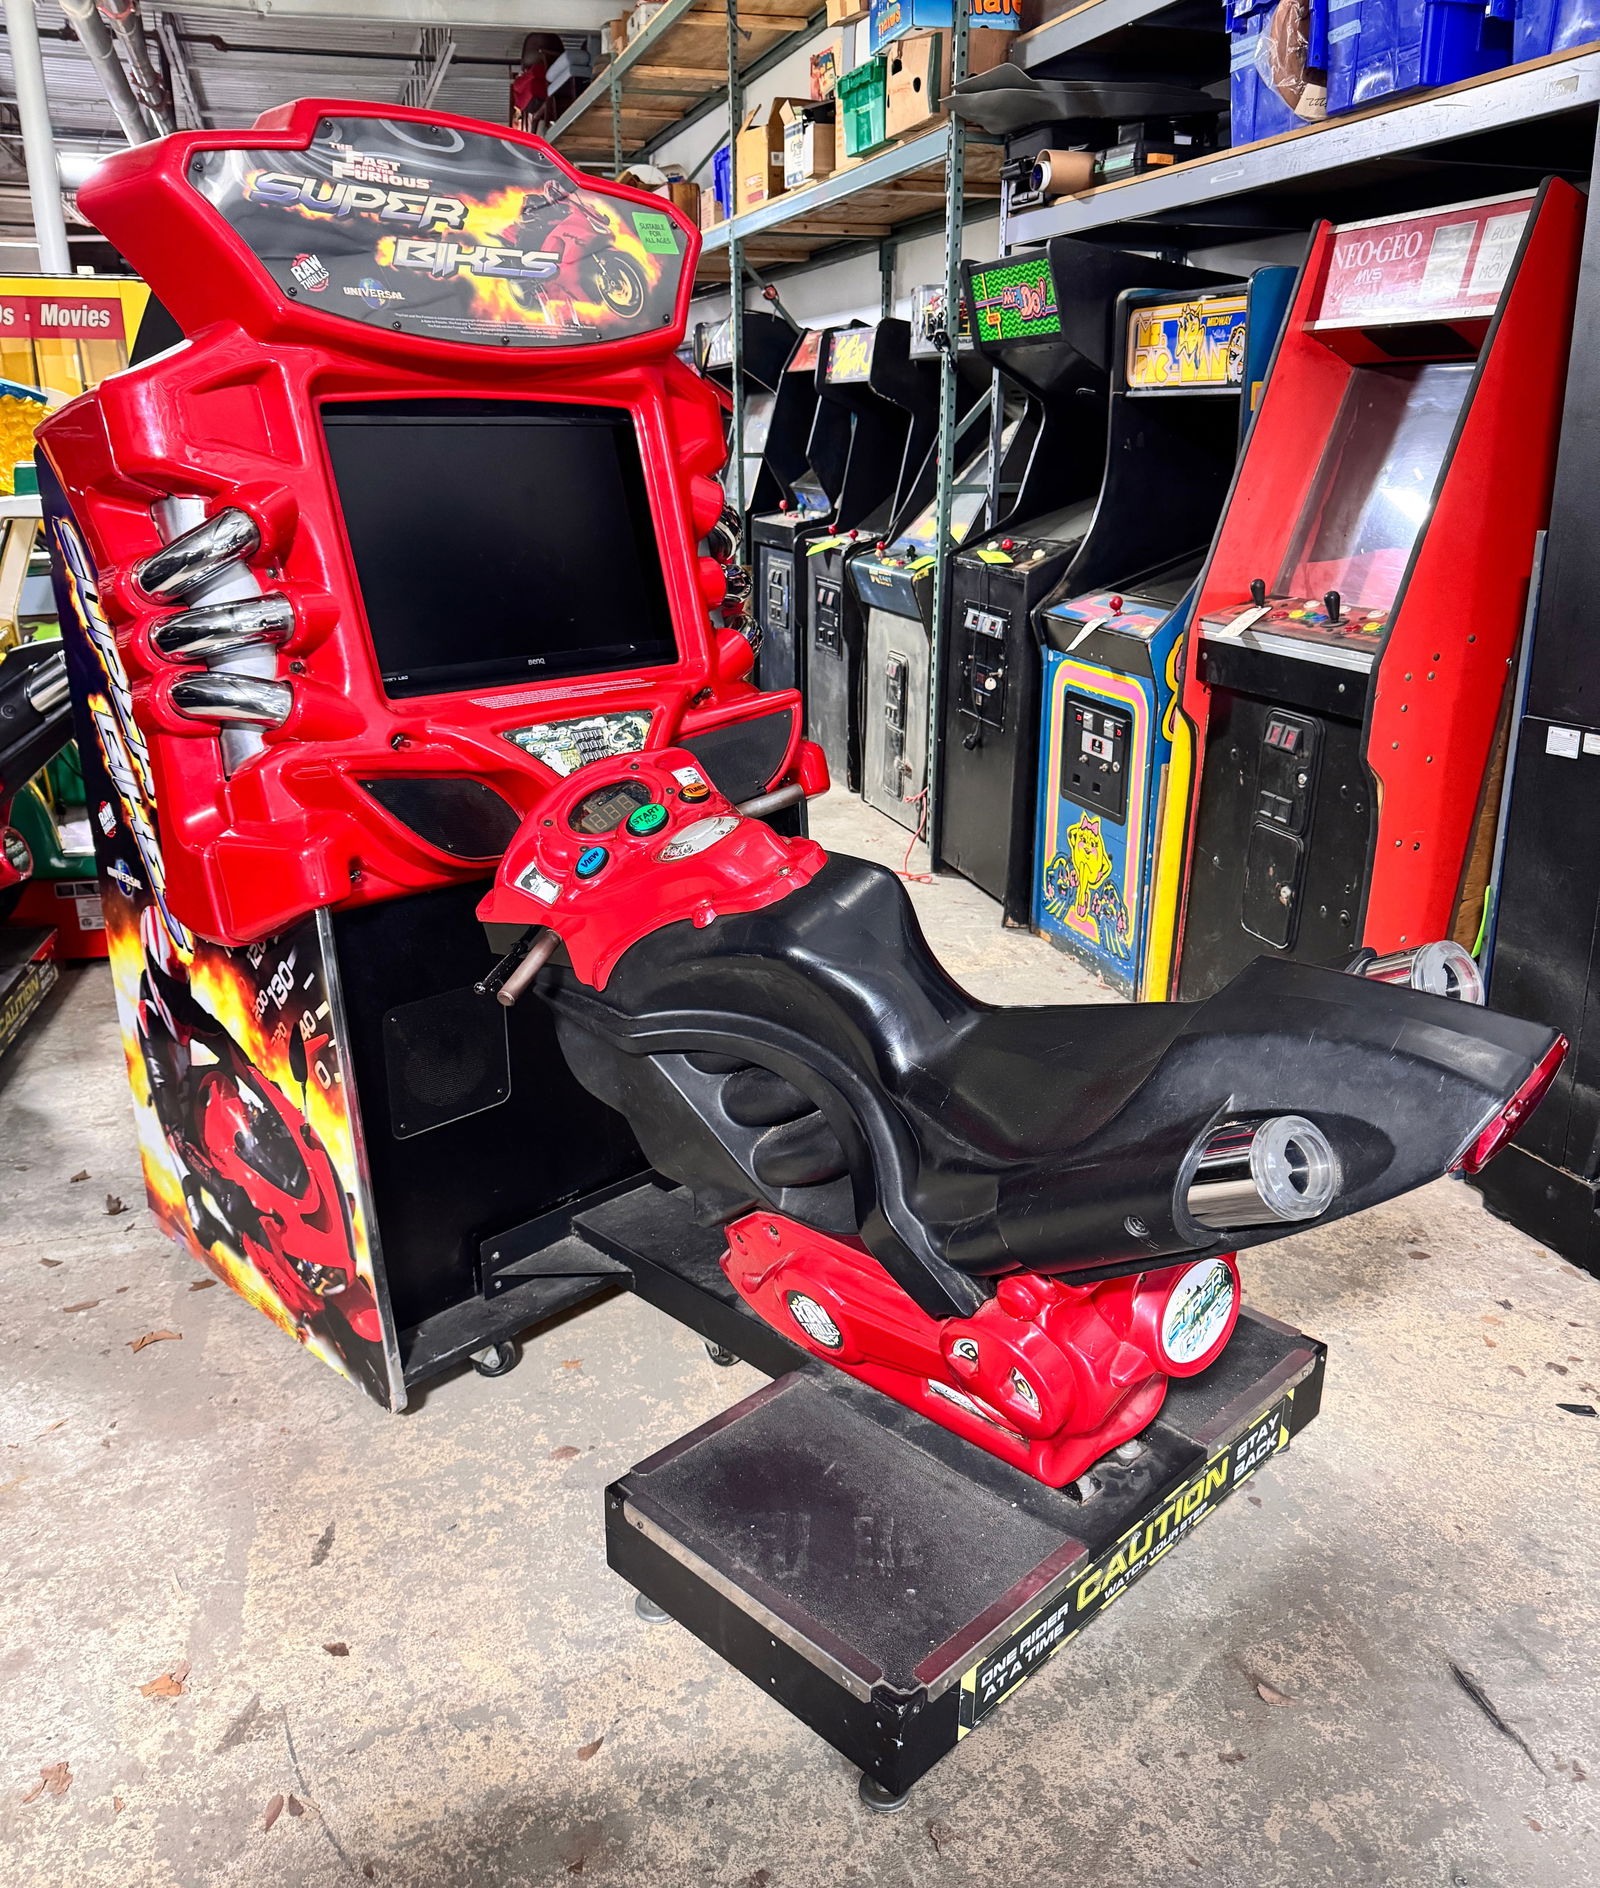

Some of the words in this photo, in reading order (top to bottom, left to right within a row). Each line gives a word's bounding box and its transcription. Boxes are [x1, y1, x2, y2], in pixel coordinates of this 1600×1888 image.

[328, 141, 353, 152] THE
[332, 161, 430, 189] FURIOUS
[346, 150, 401, 172] FAST
[250, 172, 469, 230] SUPER
[393, 238, 560, 278] BIKES
[1492, 243, 1504, 261] A
[290, 254, 323, 280] RAW
[301, 267, 330, 290] THRILLS
[1353, 267, 1384, 287] MVS
[343, 286, 406, 300] UNIVERSAL
[41, 303, 111, 328] Movies
[1206, 315, 1233, 327] MIDWAY
[1135, 338, 1228, 384] PAC-MAN
[632, 805, 660, 825] START
[580, 850, 600, 868] VIEW
[267, 960, 295, 1011] 130
[314, 1059, 332, 1090] 0
[1236, 1413, 1280, 1461] STAY
[1233, 1430, 1278, 1482] BACK
[1076, 1456, 1229, 1613] CAUTION
[1103, 1558, 1148, 1601] WATCH
[1149, 1528, 1179, 1561] YOUR
[1179, 1501, 1208, 1534] STEP
[980, 1648, 1018, 1690] ONE
[1019, 1602, 1070, 1655] RIDER
[982, 1670, 1007, 1704] AT
[1006, 1661, 1023, 1683] A
[1025, 1621, 1065, 1668] TIME
